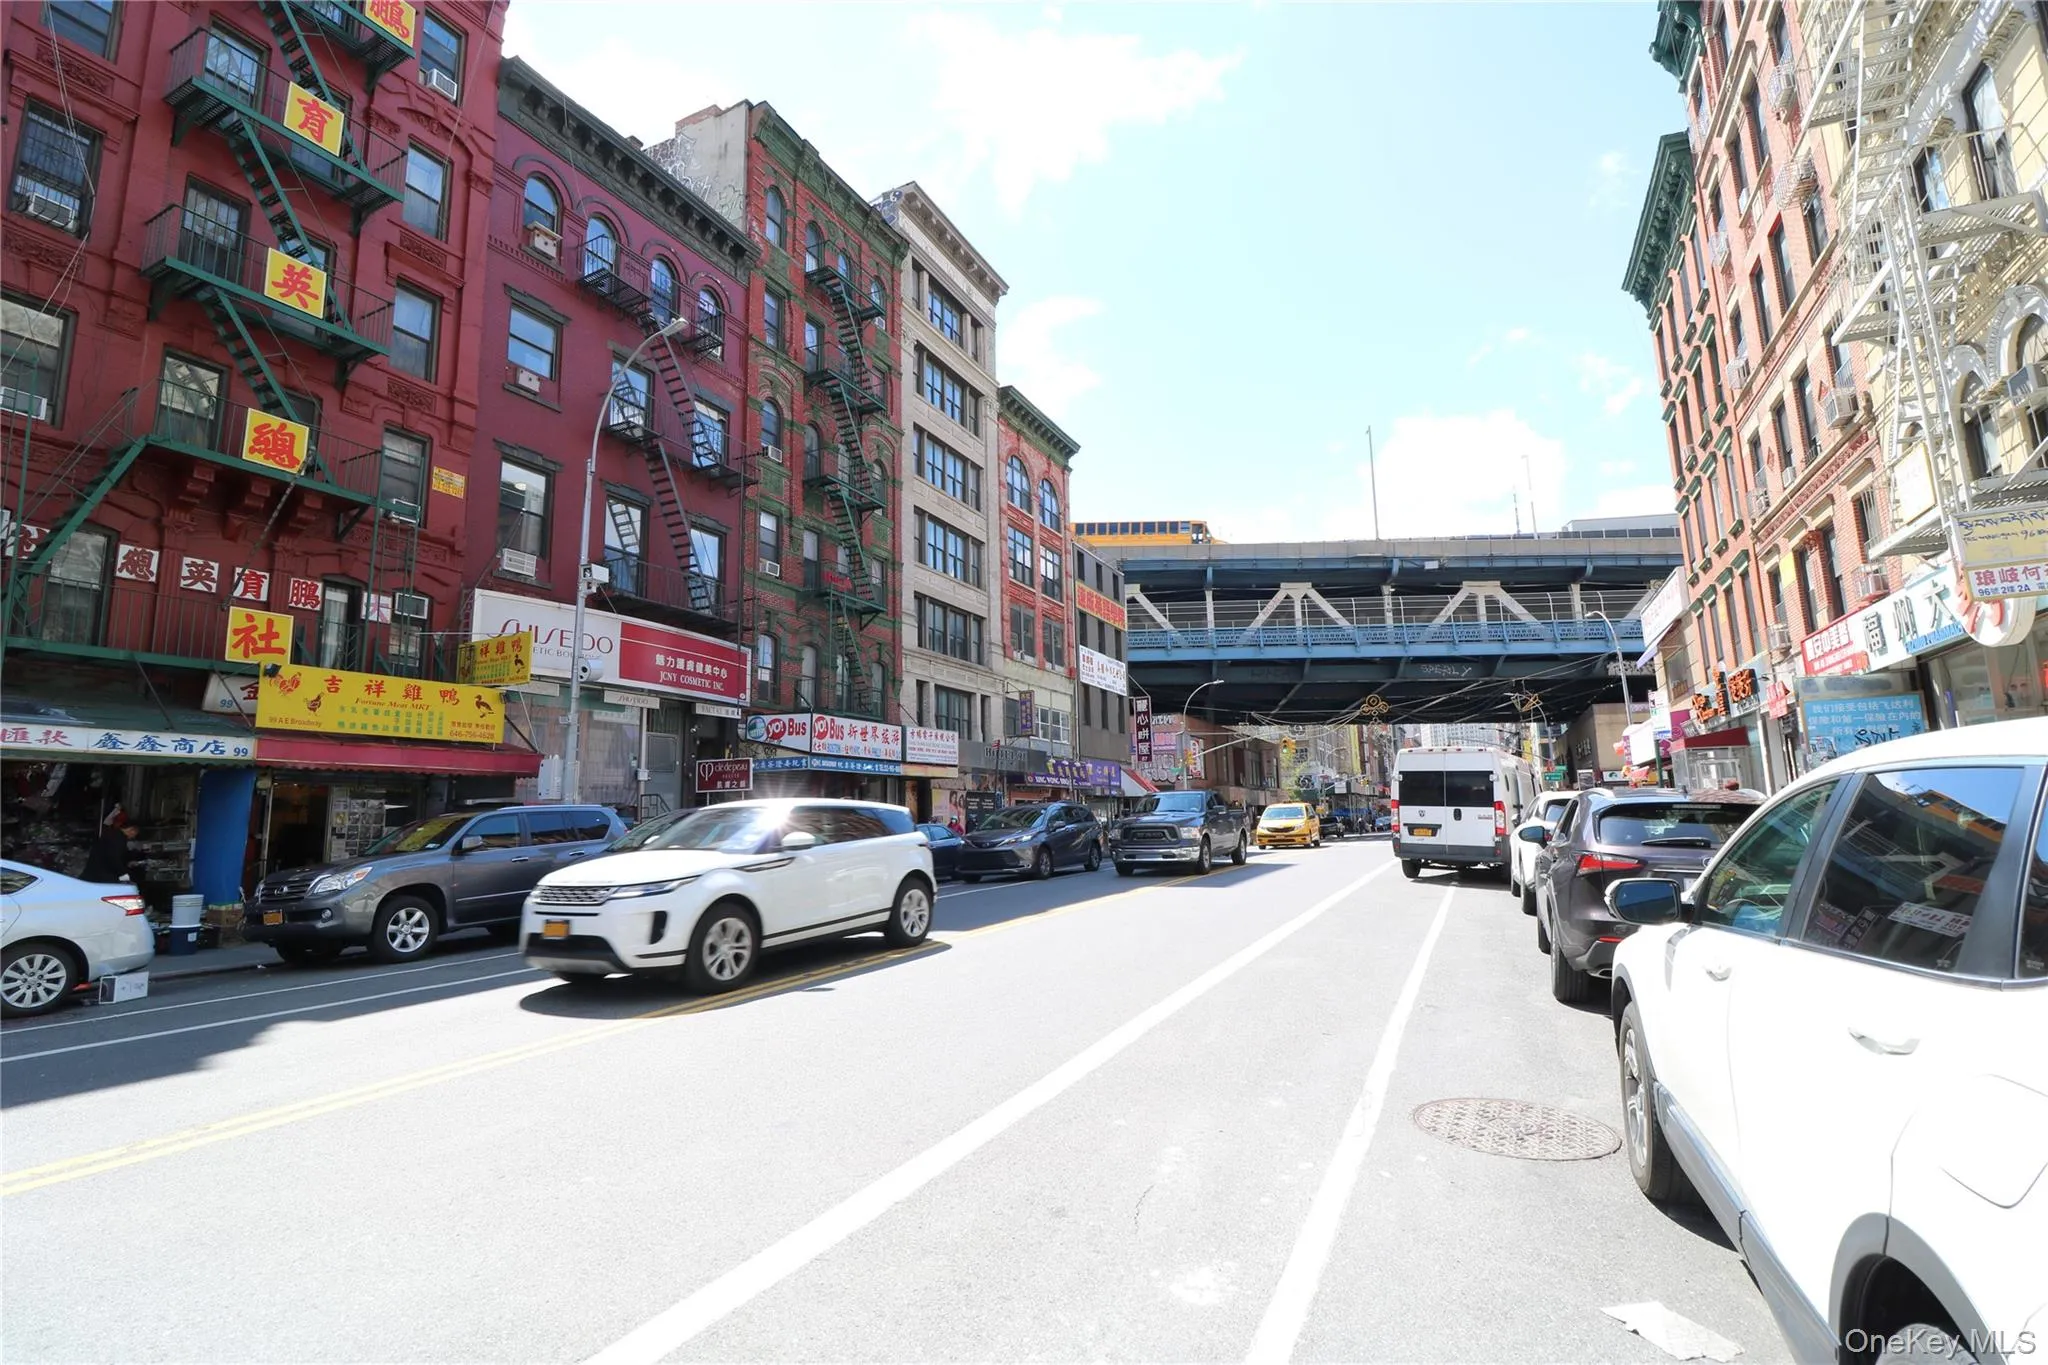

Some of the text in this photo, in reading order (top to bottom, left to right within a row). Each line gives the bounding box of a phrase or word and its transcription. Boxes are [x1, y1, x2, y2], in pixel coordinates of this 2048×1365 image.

[297, 96, 334, 144] 育
[272, 264, 319, 309] 英
[181, 560, 217, 593] 英
[237, 569, 267, 600] 育
[289, 579, 321, 609] 鵬
[2017, 584, 2031, 593] 2A
[231, 612, 287, 659] 社
[324, 674, 460, 706] 吉祥雞鴨
[680, 674, 711, 689] COSMETIC
[219, 698, 234, 710] 99
[788, 717, 807, 736] Bus
[829, 717, 845, 741] Bus
[92, 731, 249, 758] 鑫鑫商店 99
